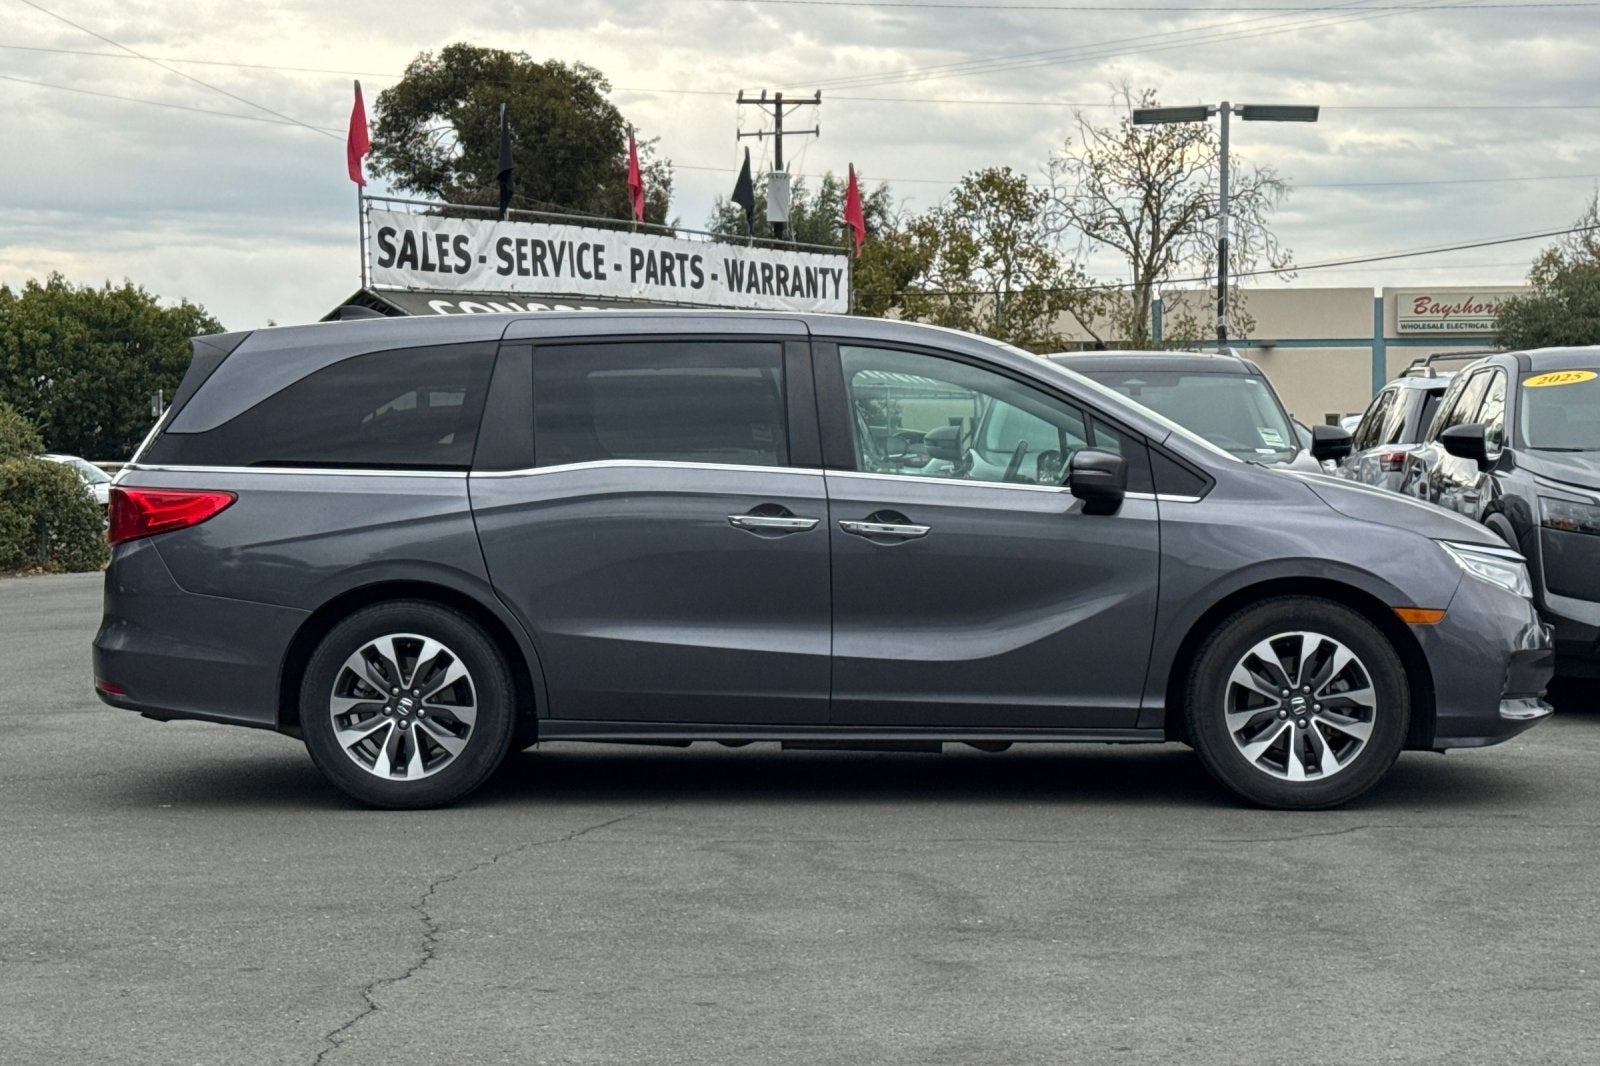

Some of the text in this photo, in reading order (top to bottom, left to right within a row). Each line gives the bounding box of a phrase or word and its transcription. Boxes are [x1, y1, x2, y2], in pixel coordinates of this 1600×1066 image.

[377, 226, 472, 275] SALES
[495, 237, 607, 281] SERVICE
[630, 247, 705, 290] PARTS
[723, 257, 843, 300] WARRANTY
[1400, 322, 1445, 330] WHOLESALE
[1446, 322, 1489, 330] ELECTRICAL
[1536, 372, 1585, 385] 2025
